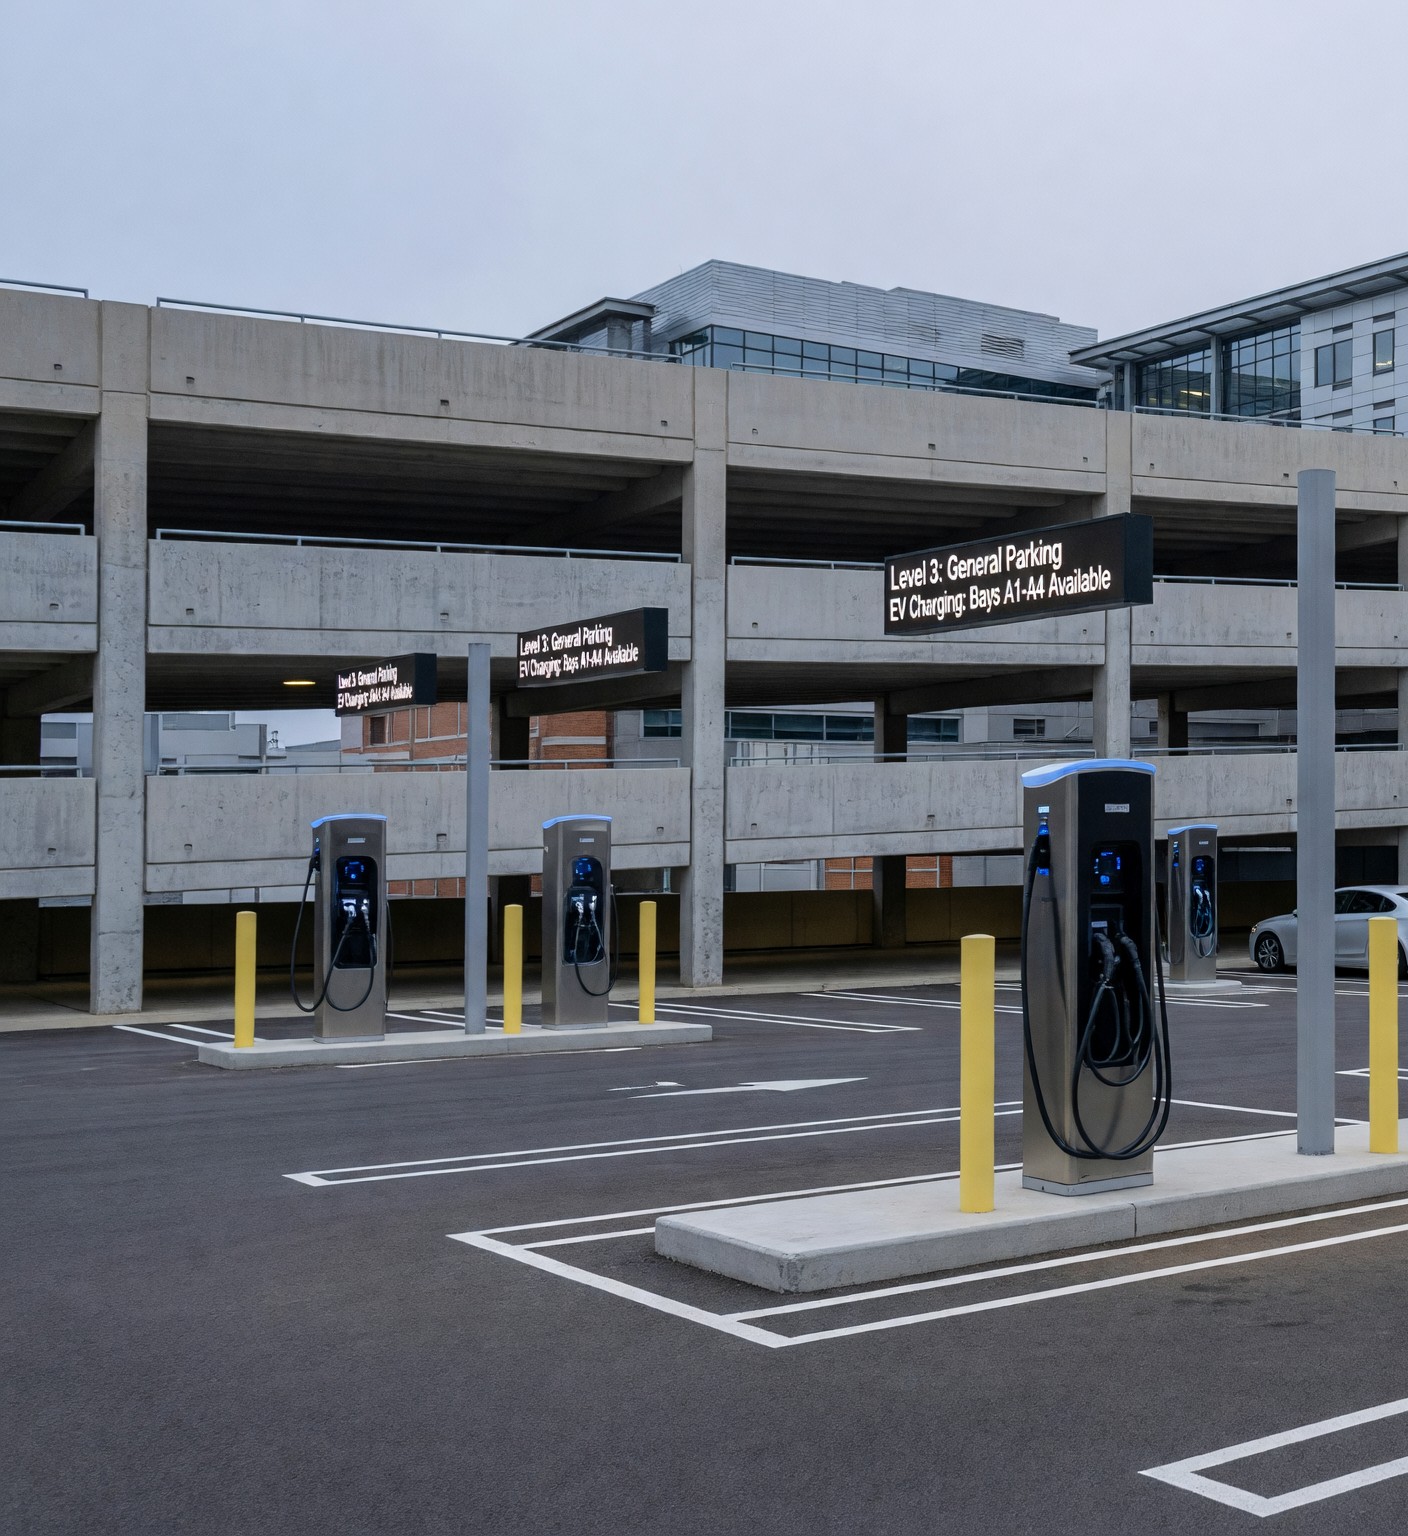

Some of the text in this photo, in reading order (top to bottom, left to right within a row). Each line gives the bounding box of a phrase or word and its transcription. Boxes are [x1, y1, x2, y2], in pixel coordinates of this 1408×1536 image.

[890, 540, 1063, 591] Level 3: General Parking
[890, 564, 1112, 622] EV Charging: Bays A1-A4 Available
